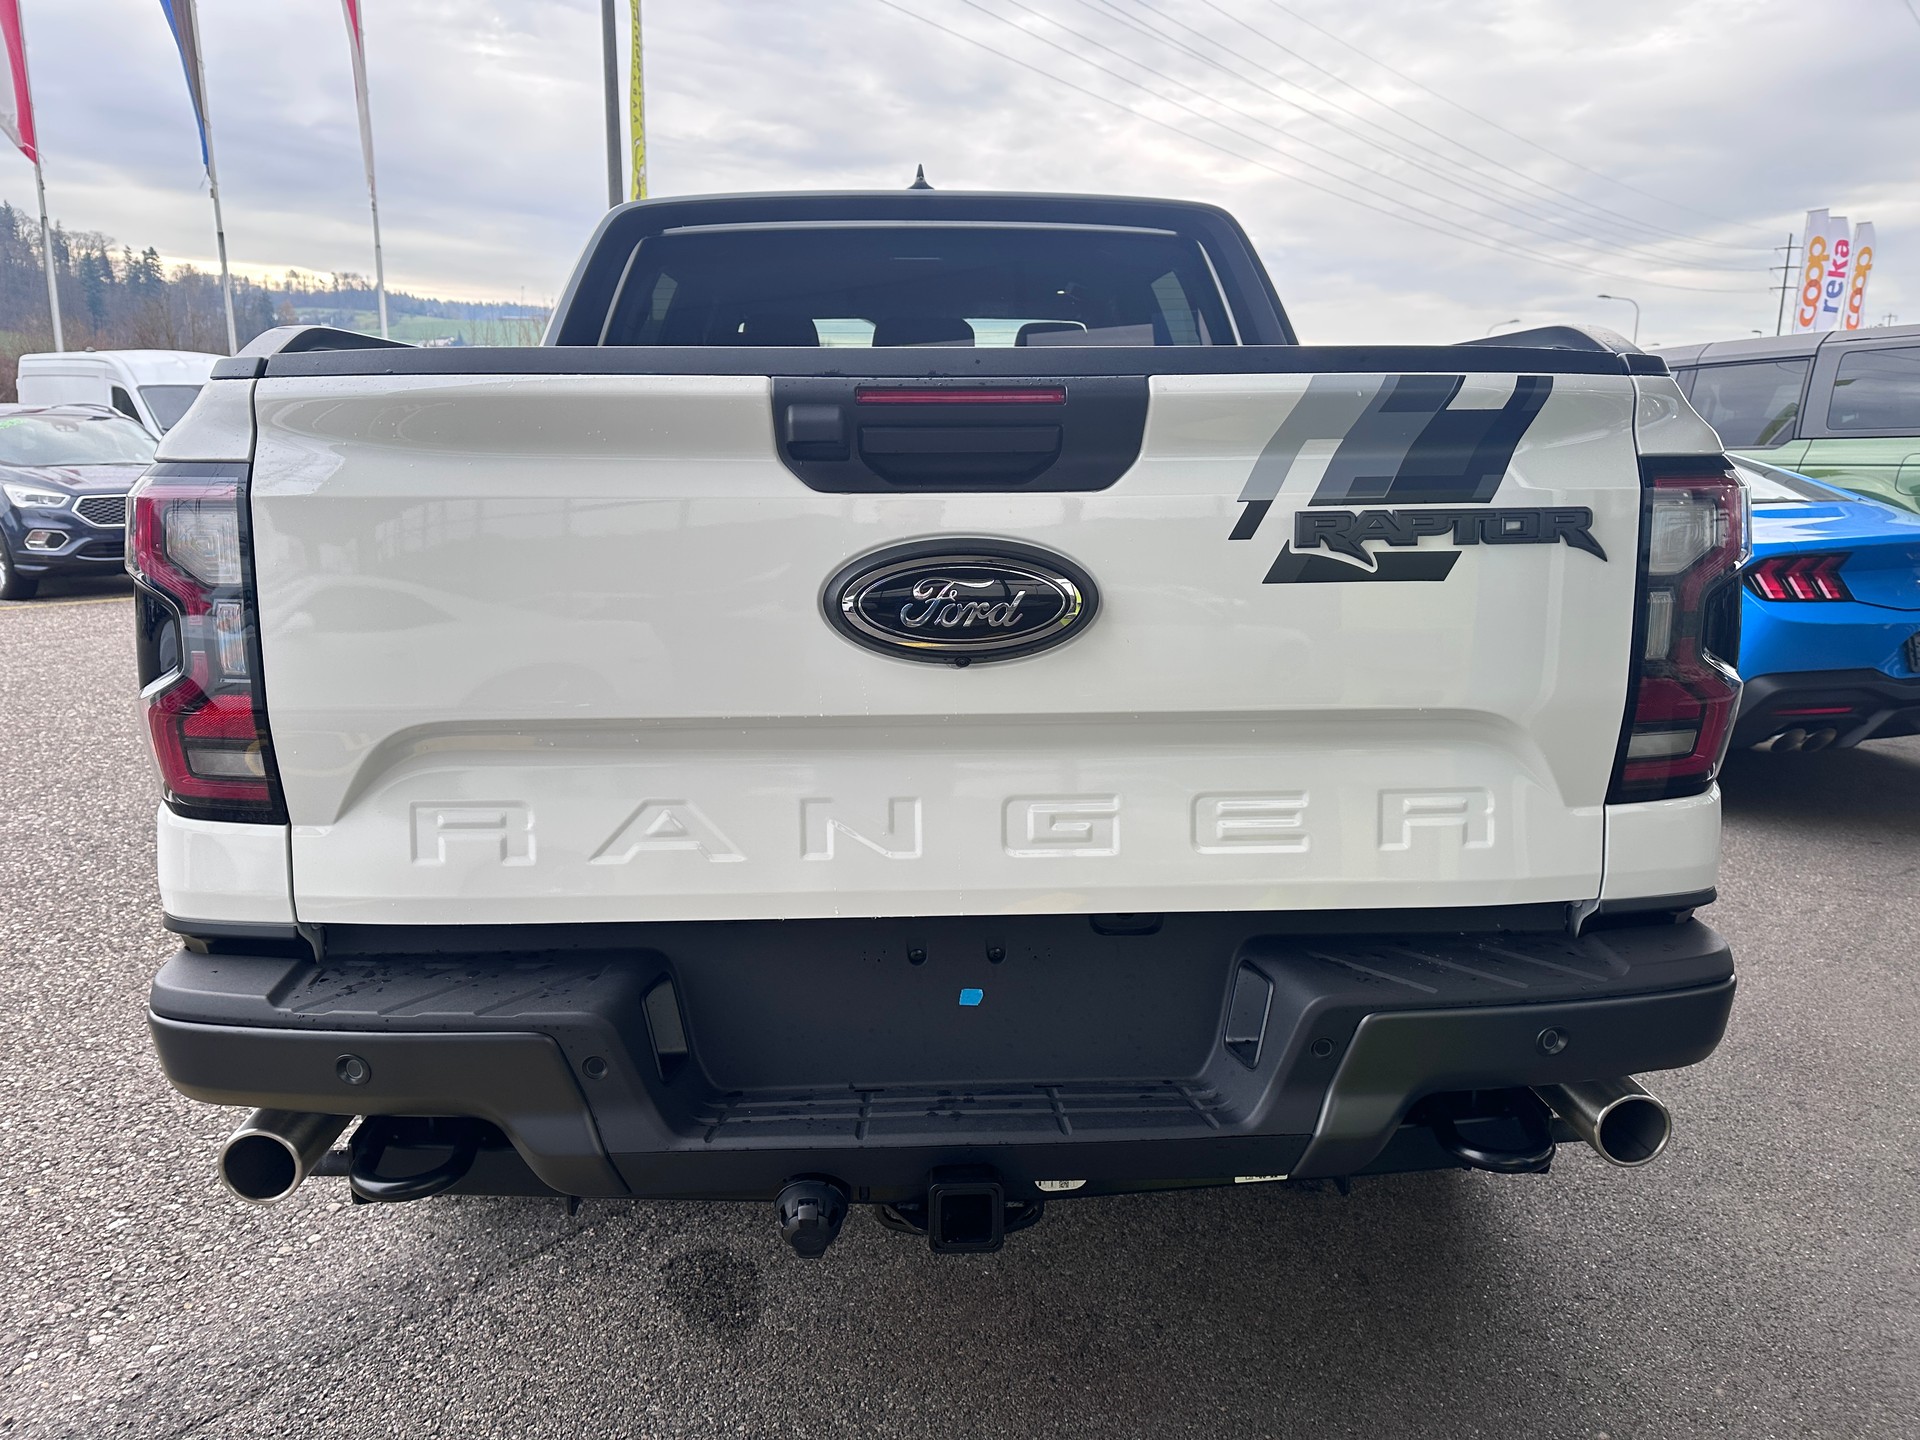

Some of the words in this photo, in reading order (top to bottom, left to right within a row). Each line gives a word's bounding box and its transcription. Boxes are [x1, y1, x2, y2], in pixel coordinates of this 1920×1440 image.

[1800, 236, 1830, 327] coop
[1823, 239, 1849, 313] reka
[1846, 246, 1873, 331] coop
[1294, 506, 1608, 567] RAPTOR
[900, 577, 1026, 628] Ford
[409, 786, 1496, 868] RANGER
